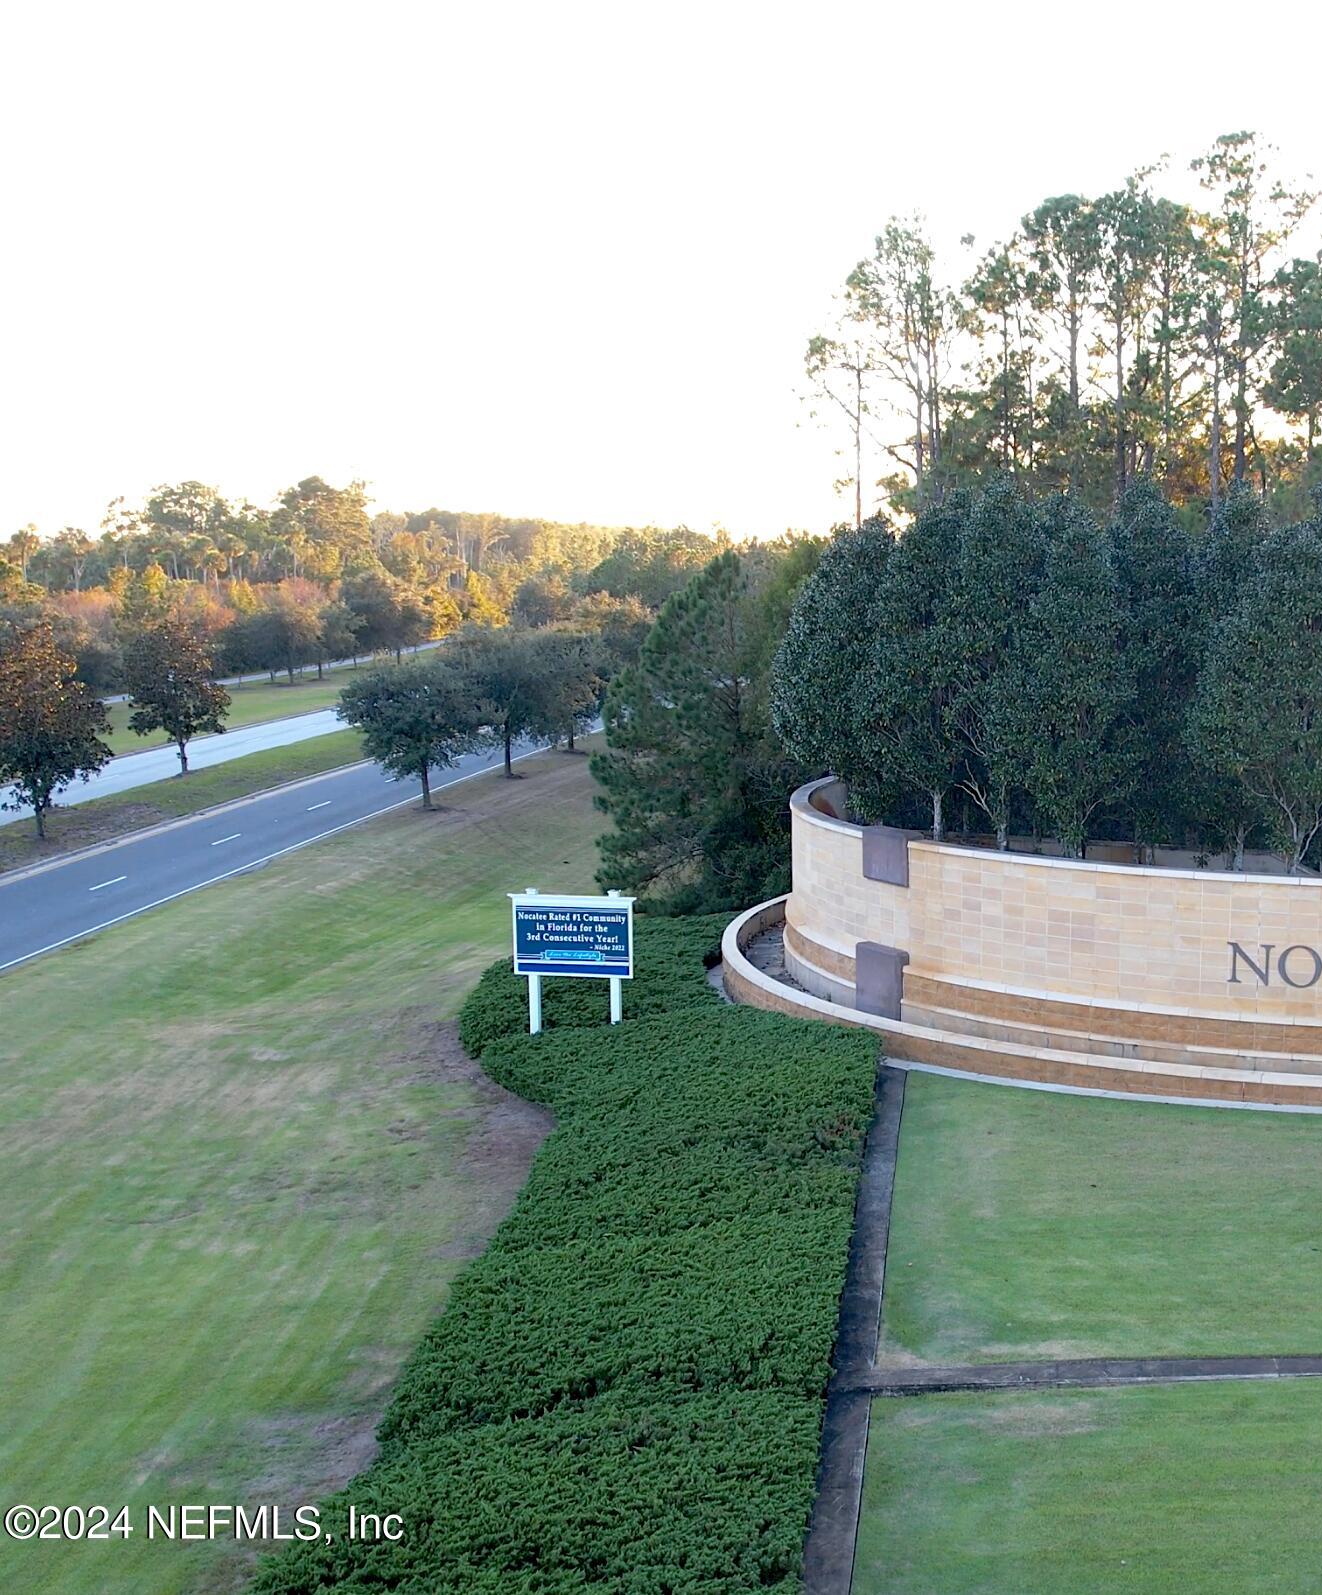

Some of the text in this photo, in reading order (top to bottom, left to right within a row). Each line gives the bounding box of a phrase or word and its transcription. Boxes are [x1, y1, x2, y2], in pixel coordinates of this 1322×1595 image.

[518, 912, 626, 924] Nocatee Rated #1 Community
[536, 922, 608, 932] in Florida for the
[526, 933, 618, 943] 3rd Consecutive Year!
